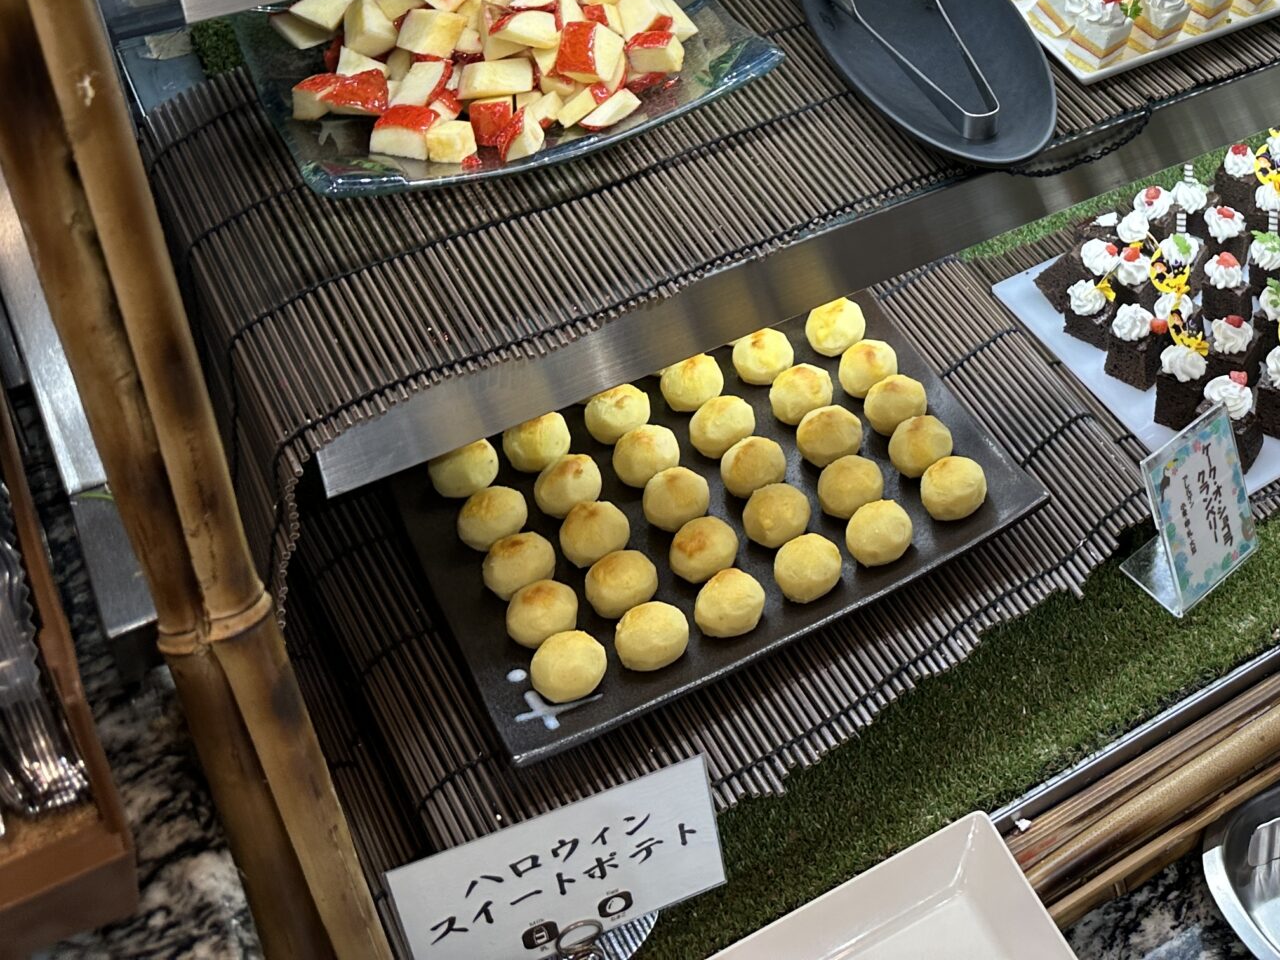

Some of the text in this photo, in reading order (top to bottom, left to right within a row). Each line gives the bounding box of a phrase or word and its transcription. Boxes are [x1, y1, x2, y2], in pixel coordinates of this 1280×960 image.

[1197, 470, 1218, 543] クランベリー
[1202, 442, 1234, 547] ケーク・オ・ショコラ
[430, 823, 698, 945] スイートポテト
[464, 813, 651, 899] ハロウィン
